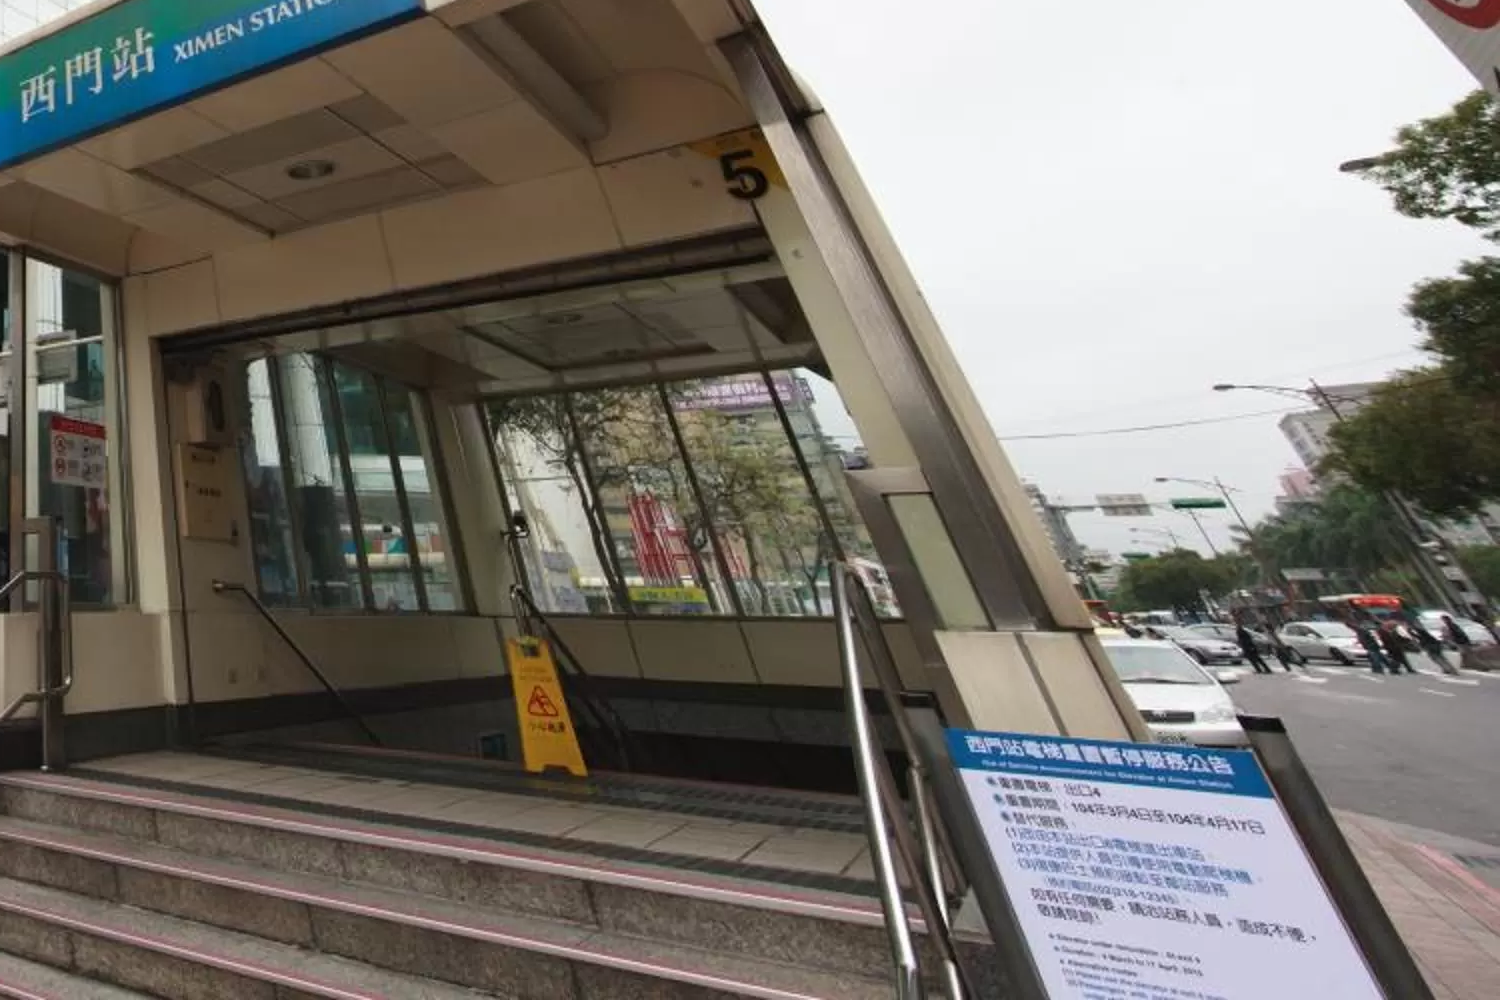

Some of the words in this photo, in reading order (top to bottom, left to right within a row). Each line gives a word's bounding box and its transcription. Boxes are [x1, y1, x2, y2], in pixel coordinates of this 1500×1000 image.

[173, 19, 244, 63] XIMEN
[20, 26, 155, 123] 西門站
[720, 148, 769, 200] 5
